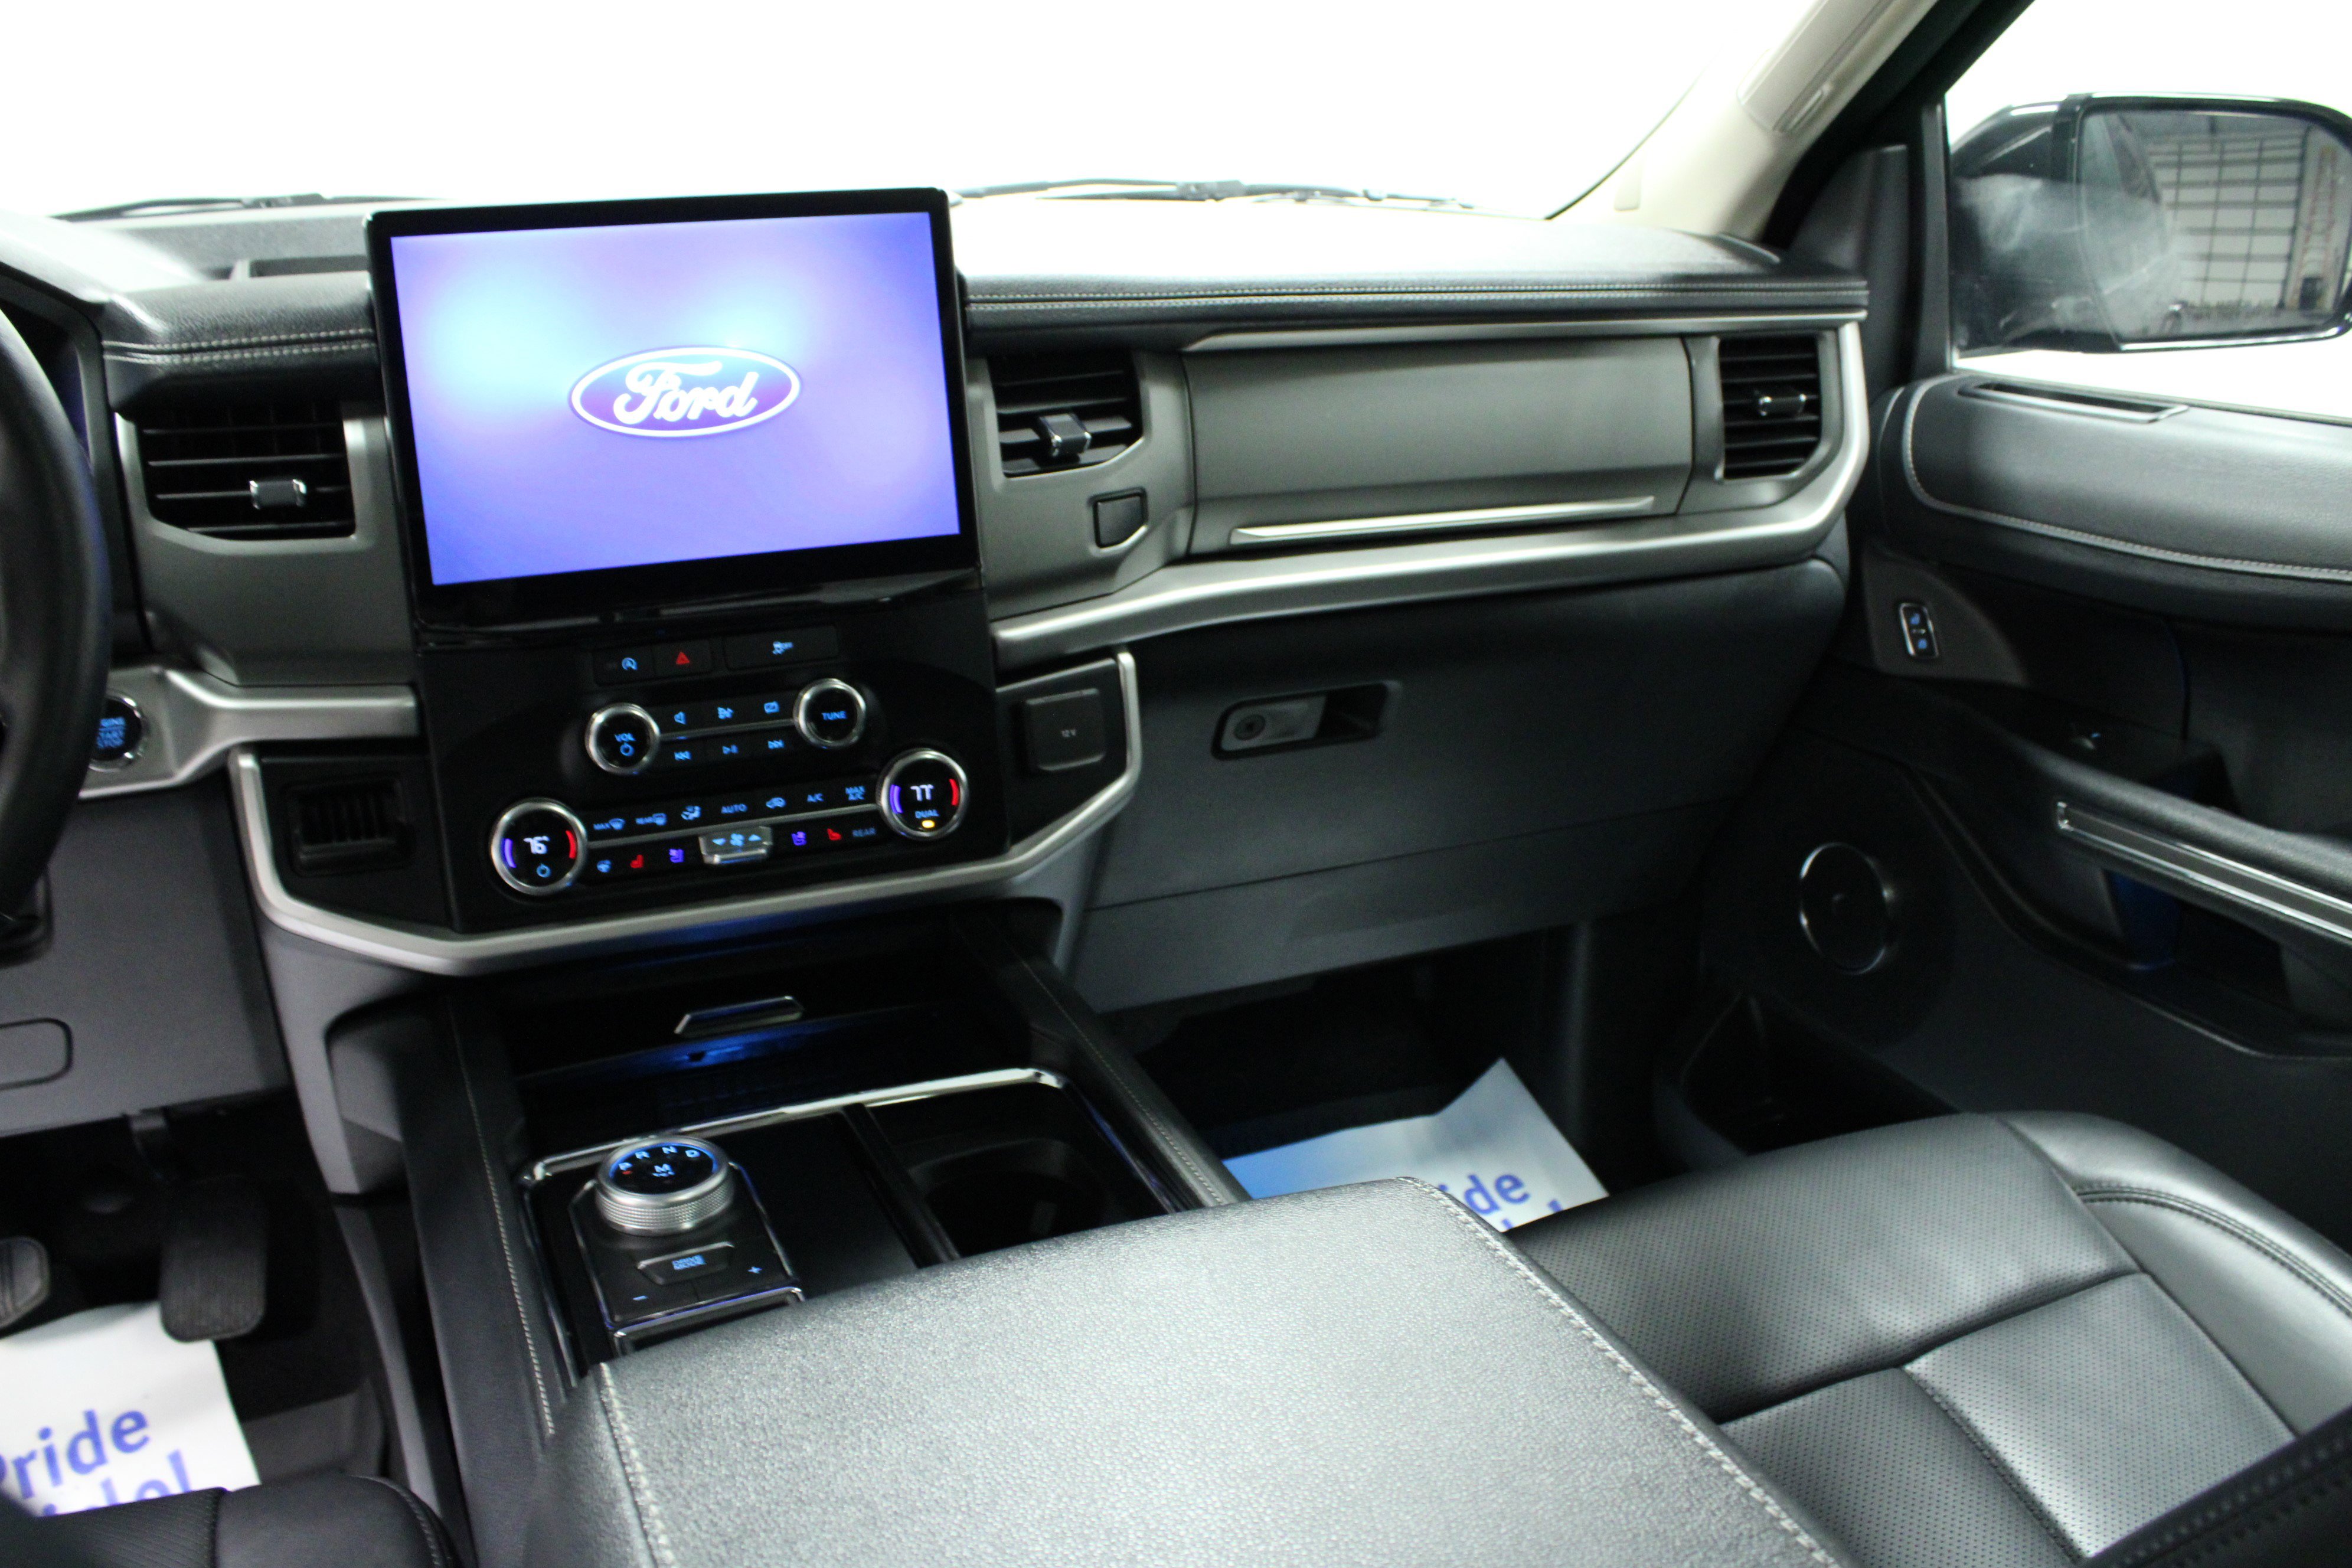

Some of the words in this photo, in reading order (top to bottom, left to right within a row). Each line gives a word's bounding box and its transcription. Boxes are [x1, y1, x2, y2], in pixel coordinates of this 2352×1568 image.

[613, 361, 759, 424] Ford
[821, 710, 848, 721] TUNE
[615, 733, 636, 743] VOL
[845, 785, 865, 795] MAX
[806, 792, 824, 802] A/C
[848, 792, 865, 801] A/C
[721, 803, 748, 814] AUTO
[915, 809, 940, 819] DUAL
[852, 828, 877, 837] REAR
[618, 1162, 633, 1171] P
[635, 1151, 651, 1159] R
[662, 1146, 678, 1154] N
[685, 1149, 701, 1158] D
[654, 1164, 673, 1173] M
[0, 1409, 149, 1500] ride
